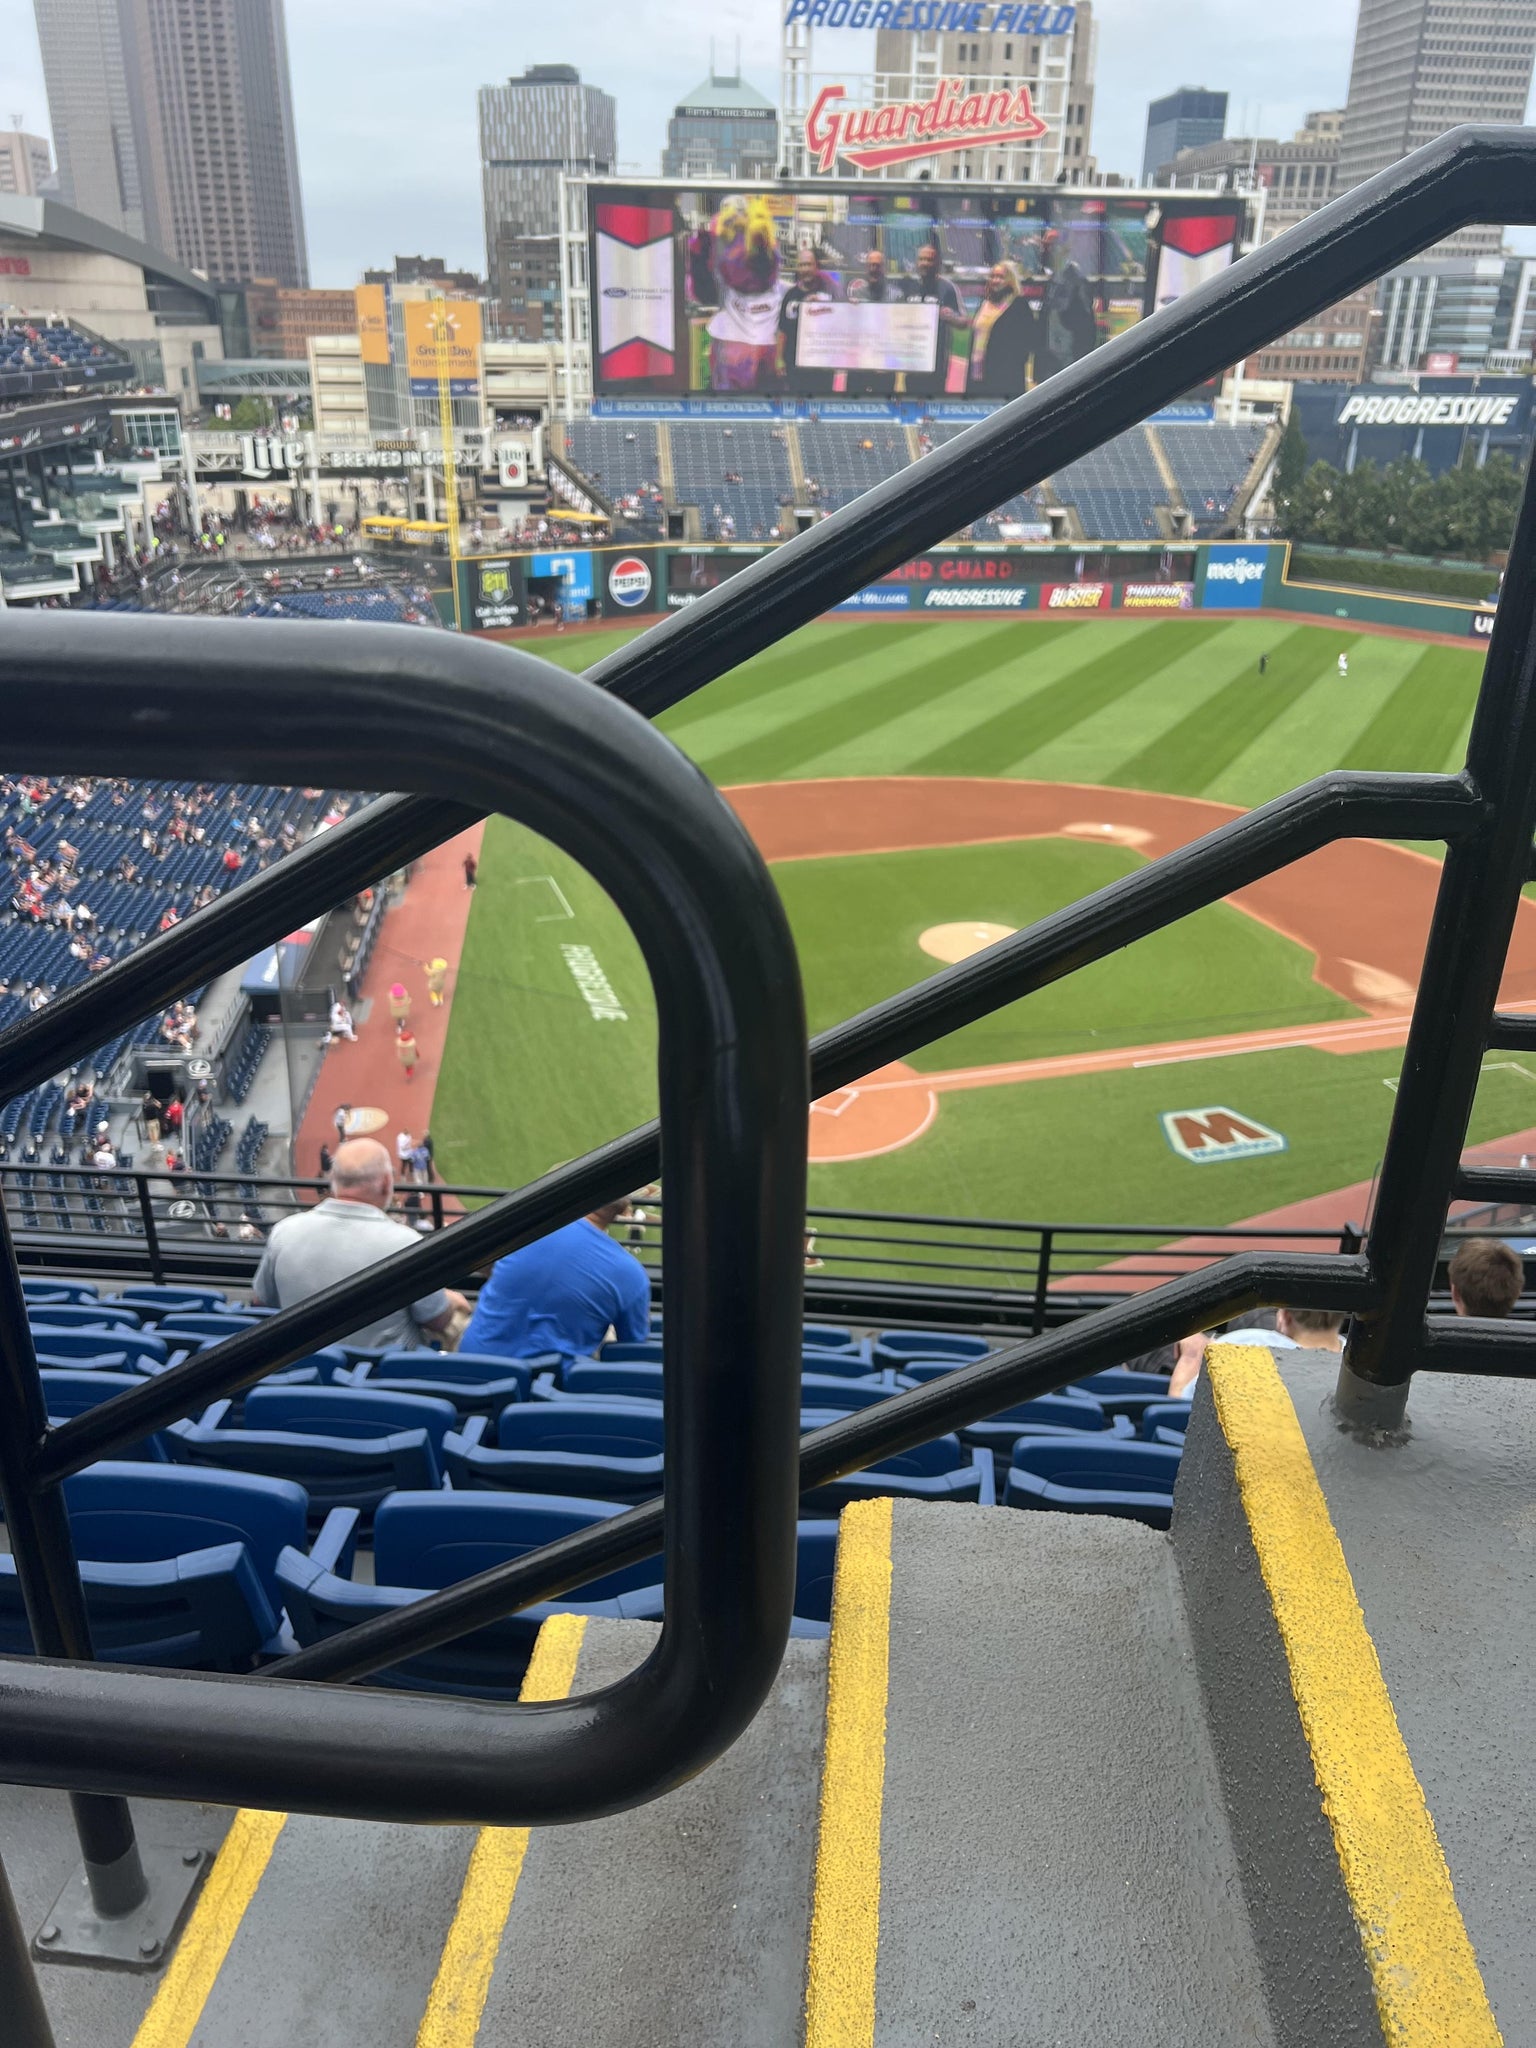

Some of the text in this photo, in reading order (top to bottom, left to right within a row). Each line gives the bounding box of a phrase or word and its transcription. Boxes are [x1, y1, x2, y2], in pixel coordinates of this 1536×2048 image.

[785, 0, 1076, 35] PROGRESSIVE FIELD
[804, 77, 1048, 173] Guardians
[616, 401, 1208, 417] HONDA HONDA HONDA HOND ONDA
[1337, 395, 1520, 425] PROGRESSIVE
[237, 434, 305, 479] Lite
[330, 450, 461, 468] BREWED IN OHO
[940, 560, 1013, 580] GUARD
[1206, 556, 1266, 585] meijer
[613, 577, 648, 588] PEPSI
[924, 588, 1027, 607] PROGRESSIVE
